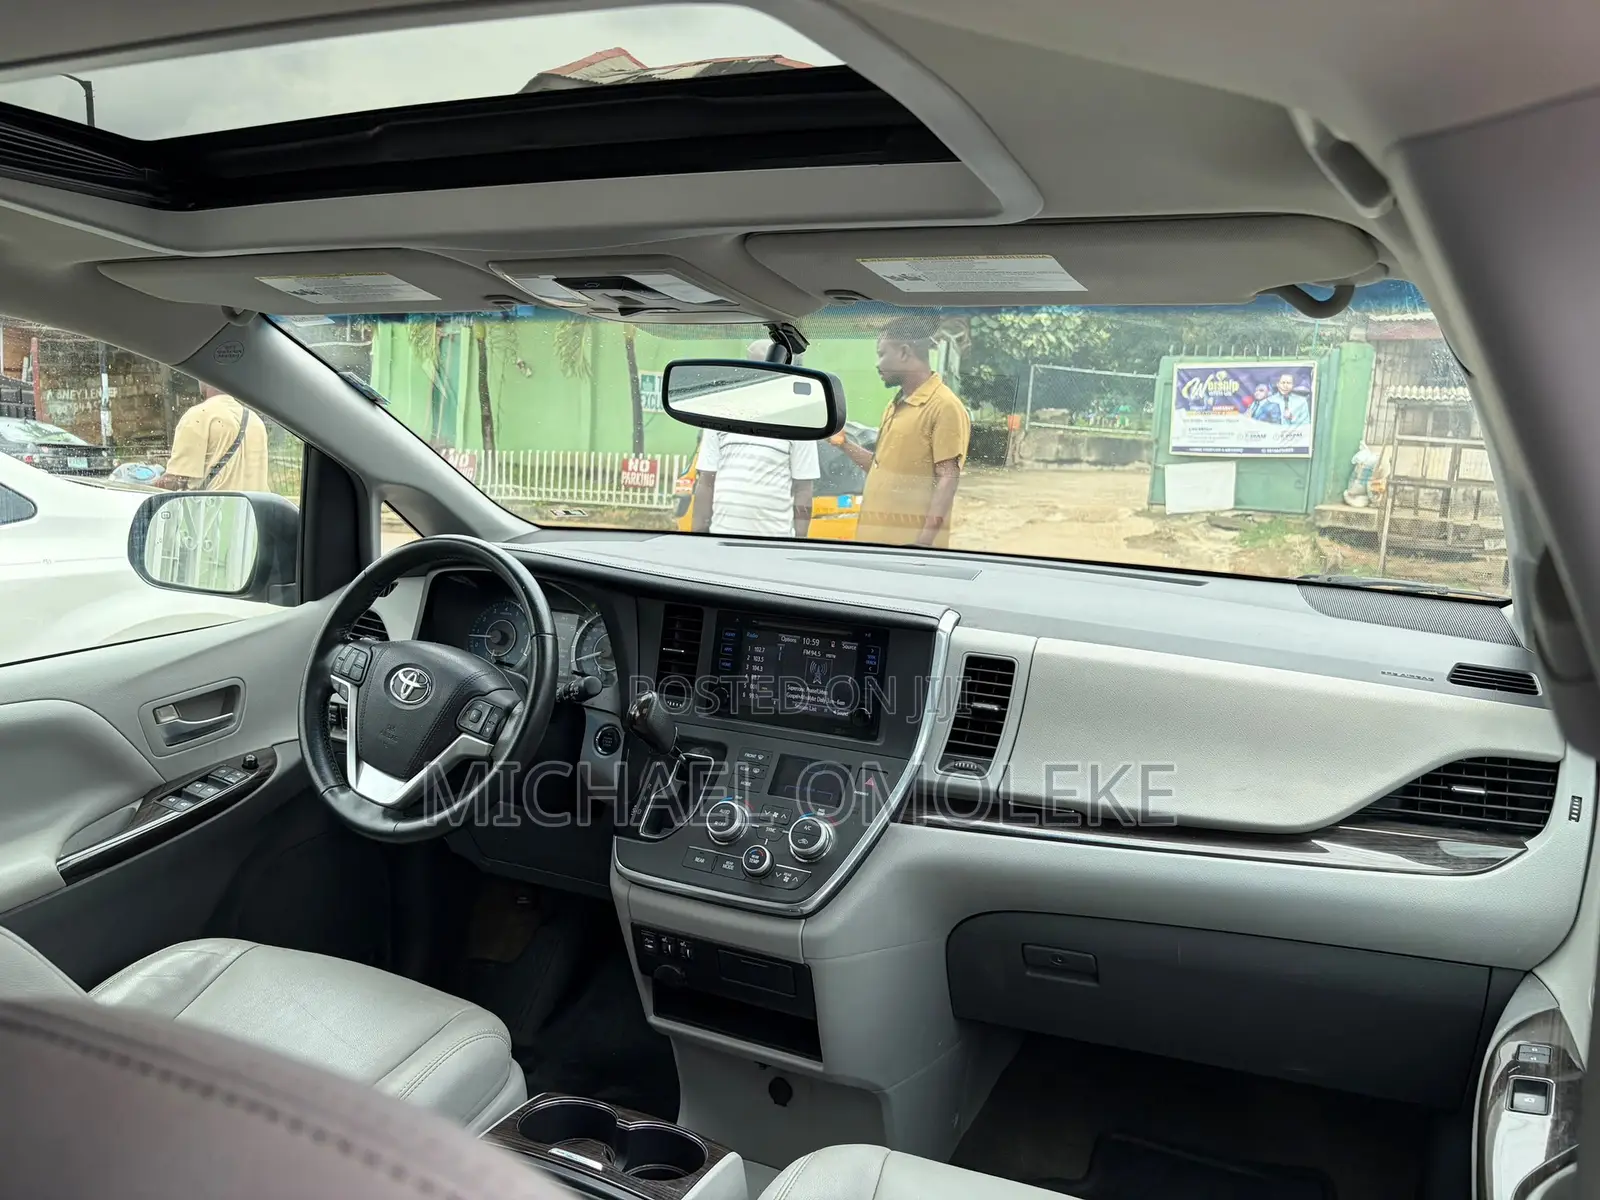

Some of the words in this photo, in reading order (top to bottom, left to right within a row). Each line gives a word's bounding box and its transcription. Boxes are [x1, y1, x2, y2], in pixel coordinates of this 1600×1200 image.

[1181, 371, 1240, 399] Worship
[627, 457, 651, 472] NO
[621, 470, 656, 488] PARKING
[746, 631, 759, 639] Radio
[780, 635, 797, 644] Options
[802, 637, 820, 647] 10:59
[842, 642, 857, 651] Source
[753, 655, 765, 663] 103.5
[695, 856, 705, 864] REAR
